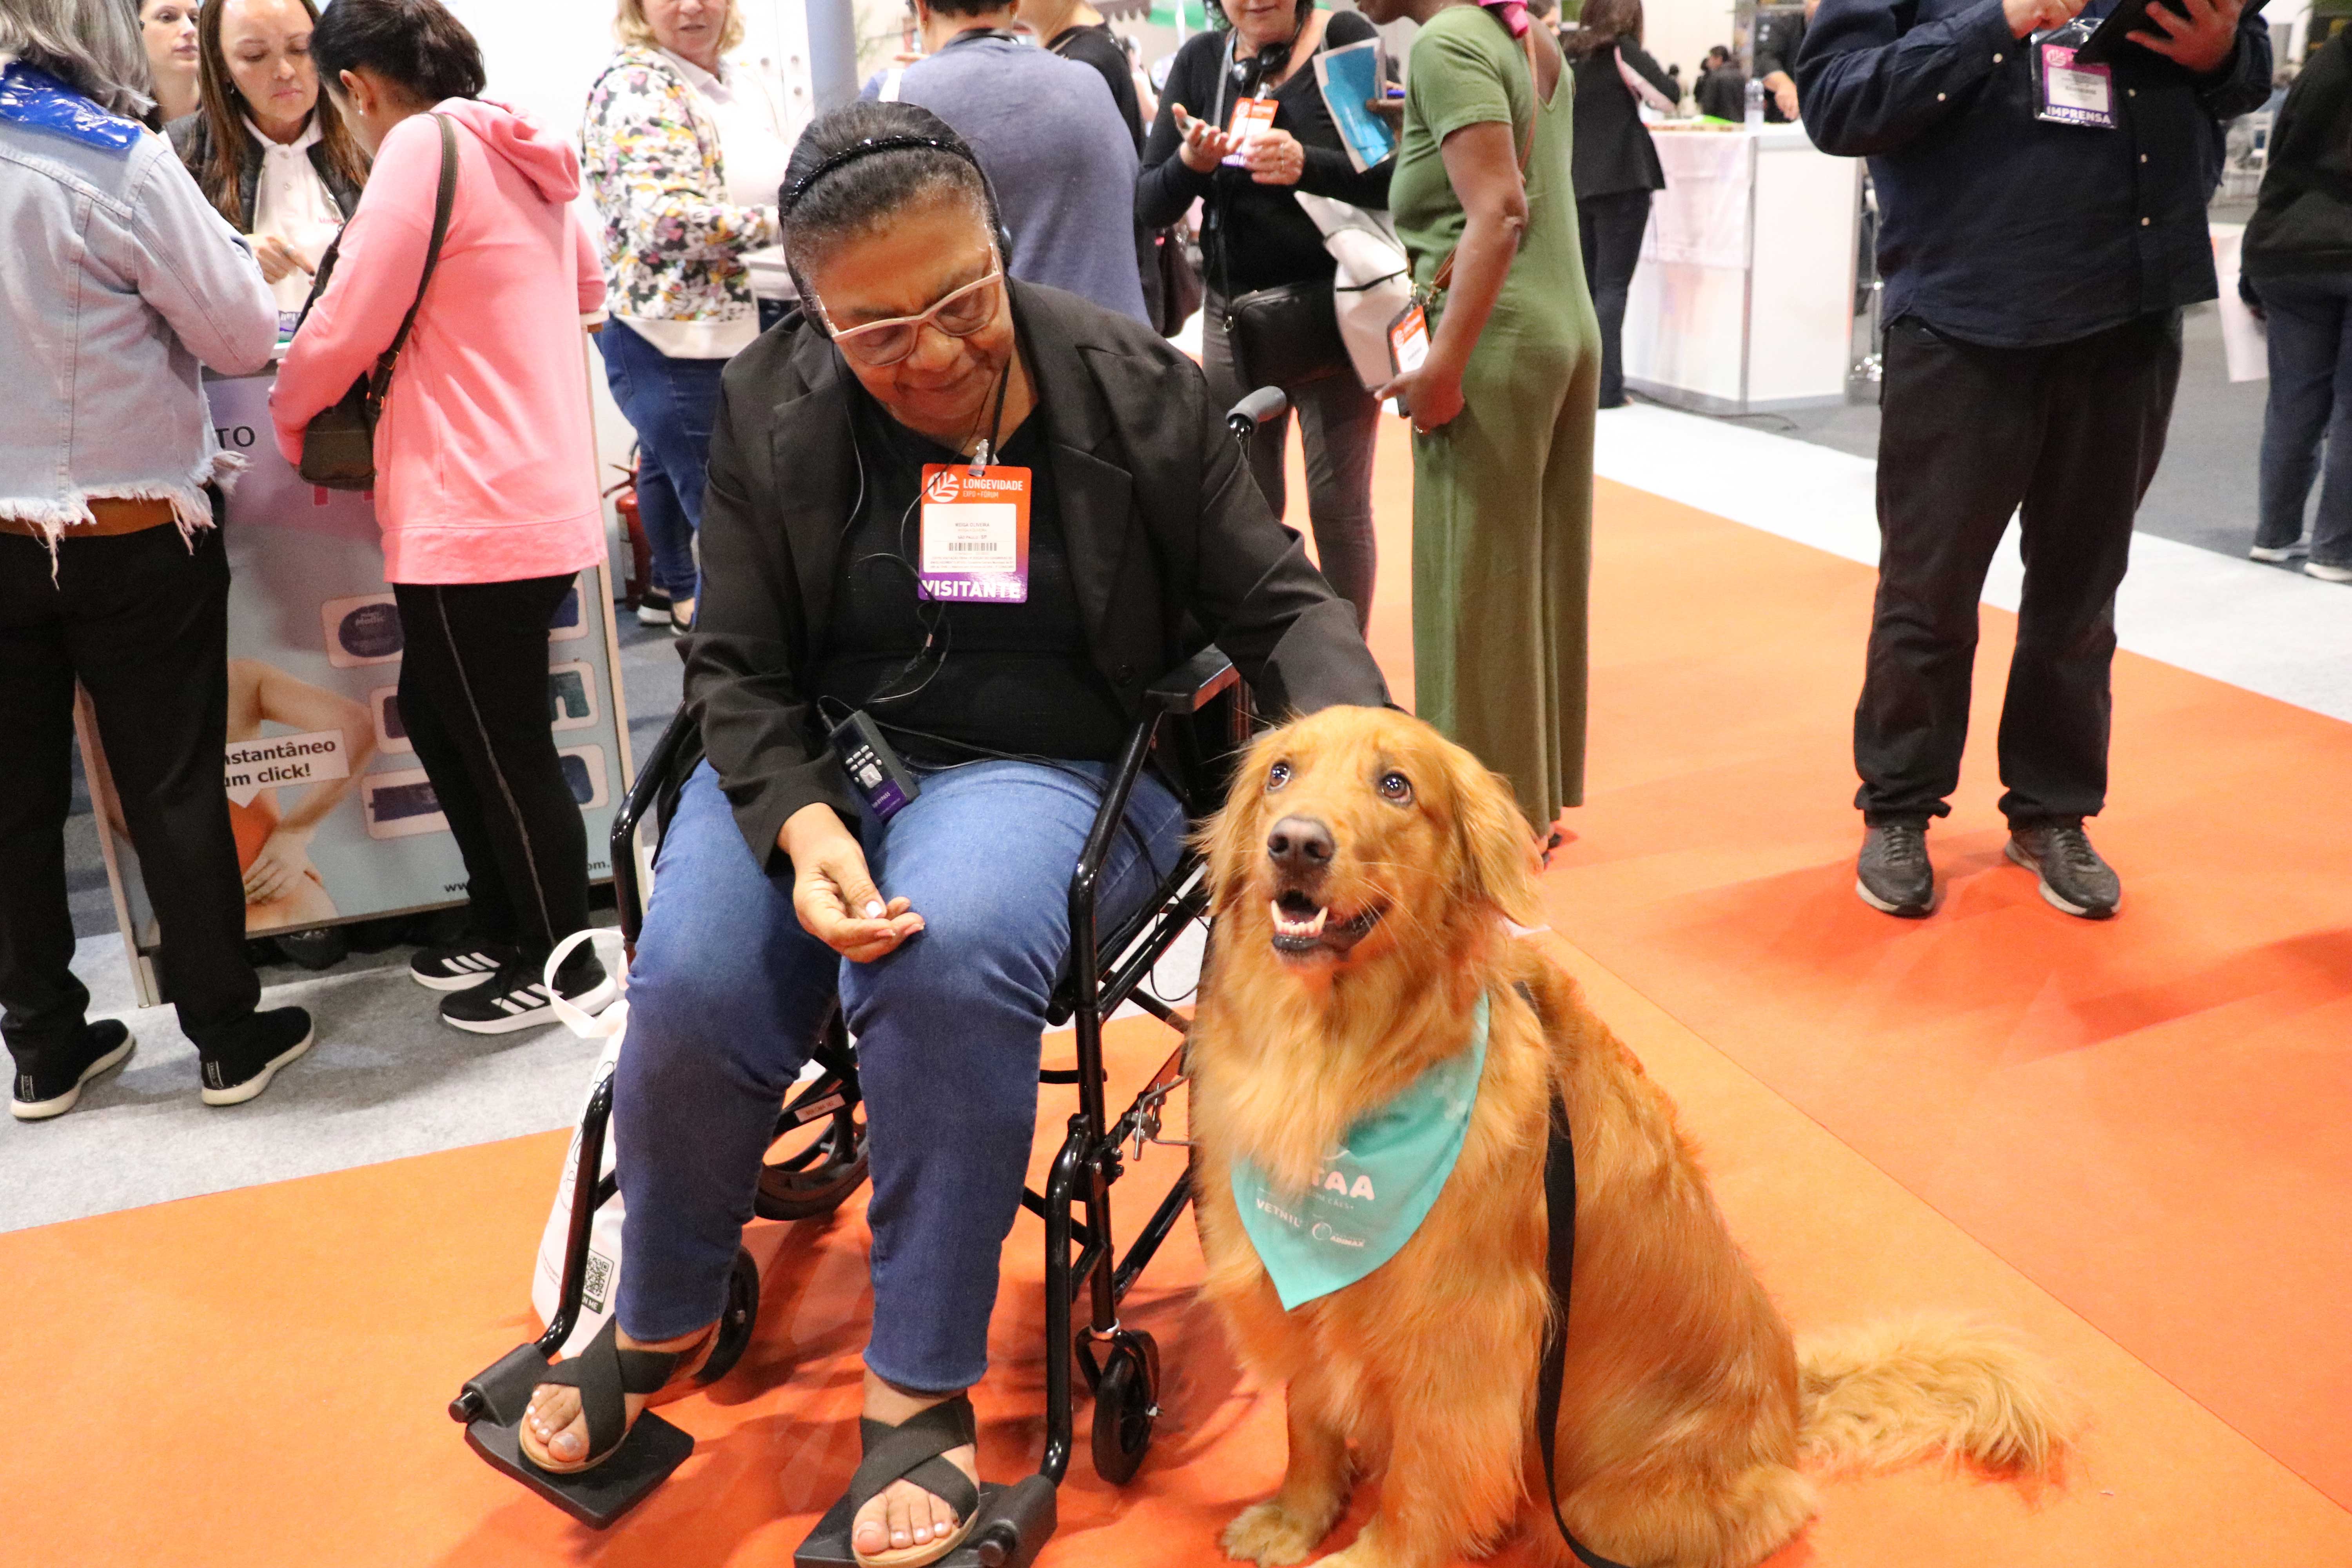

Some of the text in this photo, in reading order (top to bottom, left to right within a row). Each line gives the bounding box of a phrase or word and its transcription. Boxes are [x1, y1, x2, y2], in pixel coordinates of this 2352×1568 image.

[2046, 106, 2111, 124] IMPRENSA
[963, 478, 1023, 491] LONGEVIDADE
[921, 580, 1021, 599] VISITANTE
[258, 763, 311, 782] click!
[1256, 1198, 1299, 1228] VETNIL
